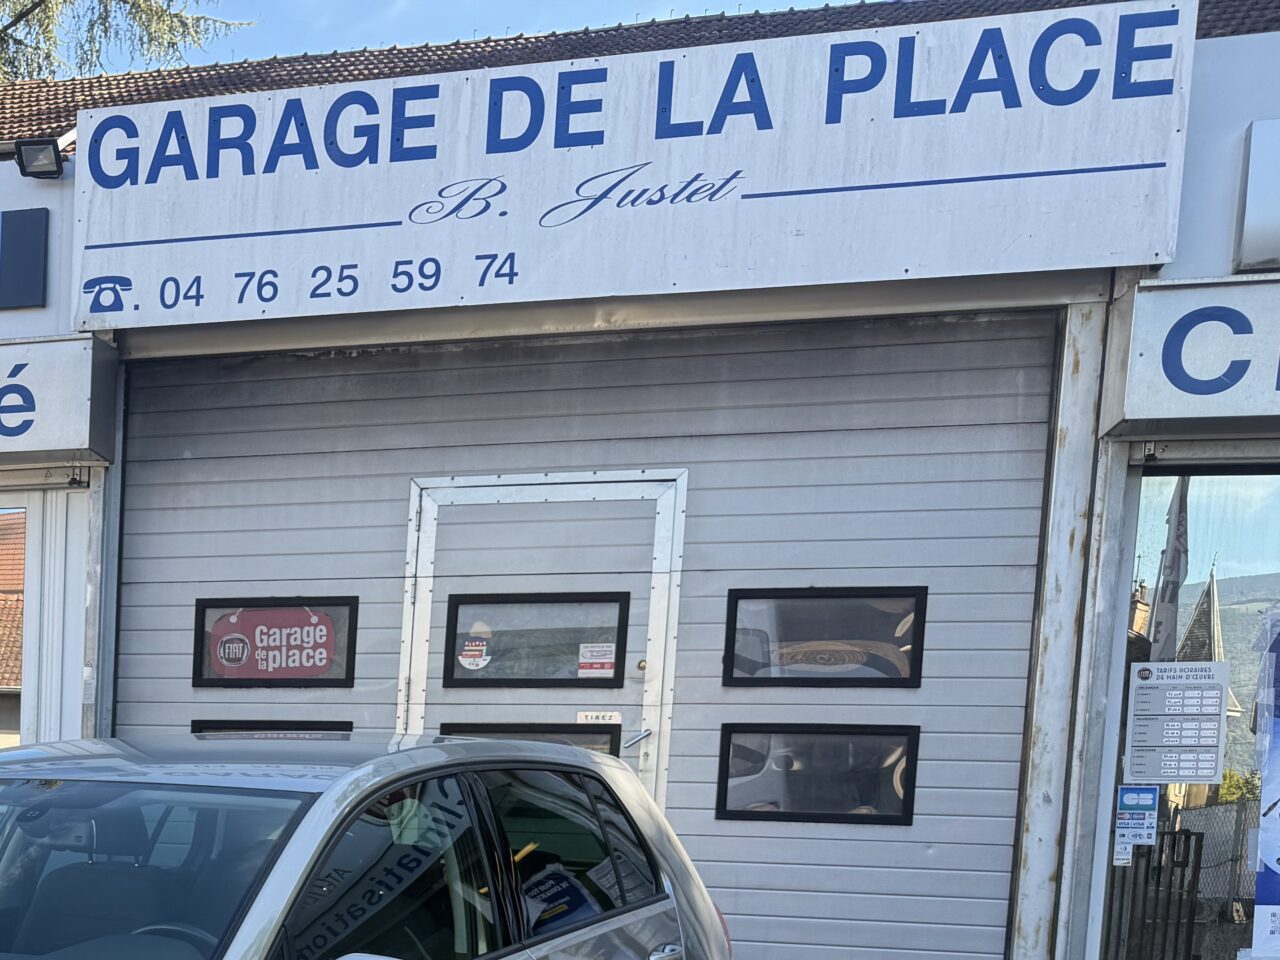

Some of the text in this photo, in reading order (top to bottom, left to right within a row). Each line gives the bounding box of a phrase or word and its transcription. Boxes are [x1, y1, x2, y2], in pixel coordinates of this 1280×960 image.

[87, 9, 1179, 189] GARAGE DE LA PLACE
[408, 162, 745, 228] B. Justet
[159, 252, 519, 309] 04 76 25 59 74
[1161, 305, 1280, 395] C
[254, 624, 328, 648] Garage
[225, 643, 244, 659] FIAT
[255, 648, 267, 660] de
[267, 647, 328, 672] place
[258, 659, 267, 670] la
[1179, 666, 1212, 674] HORAIRES
